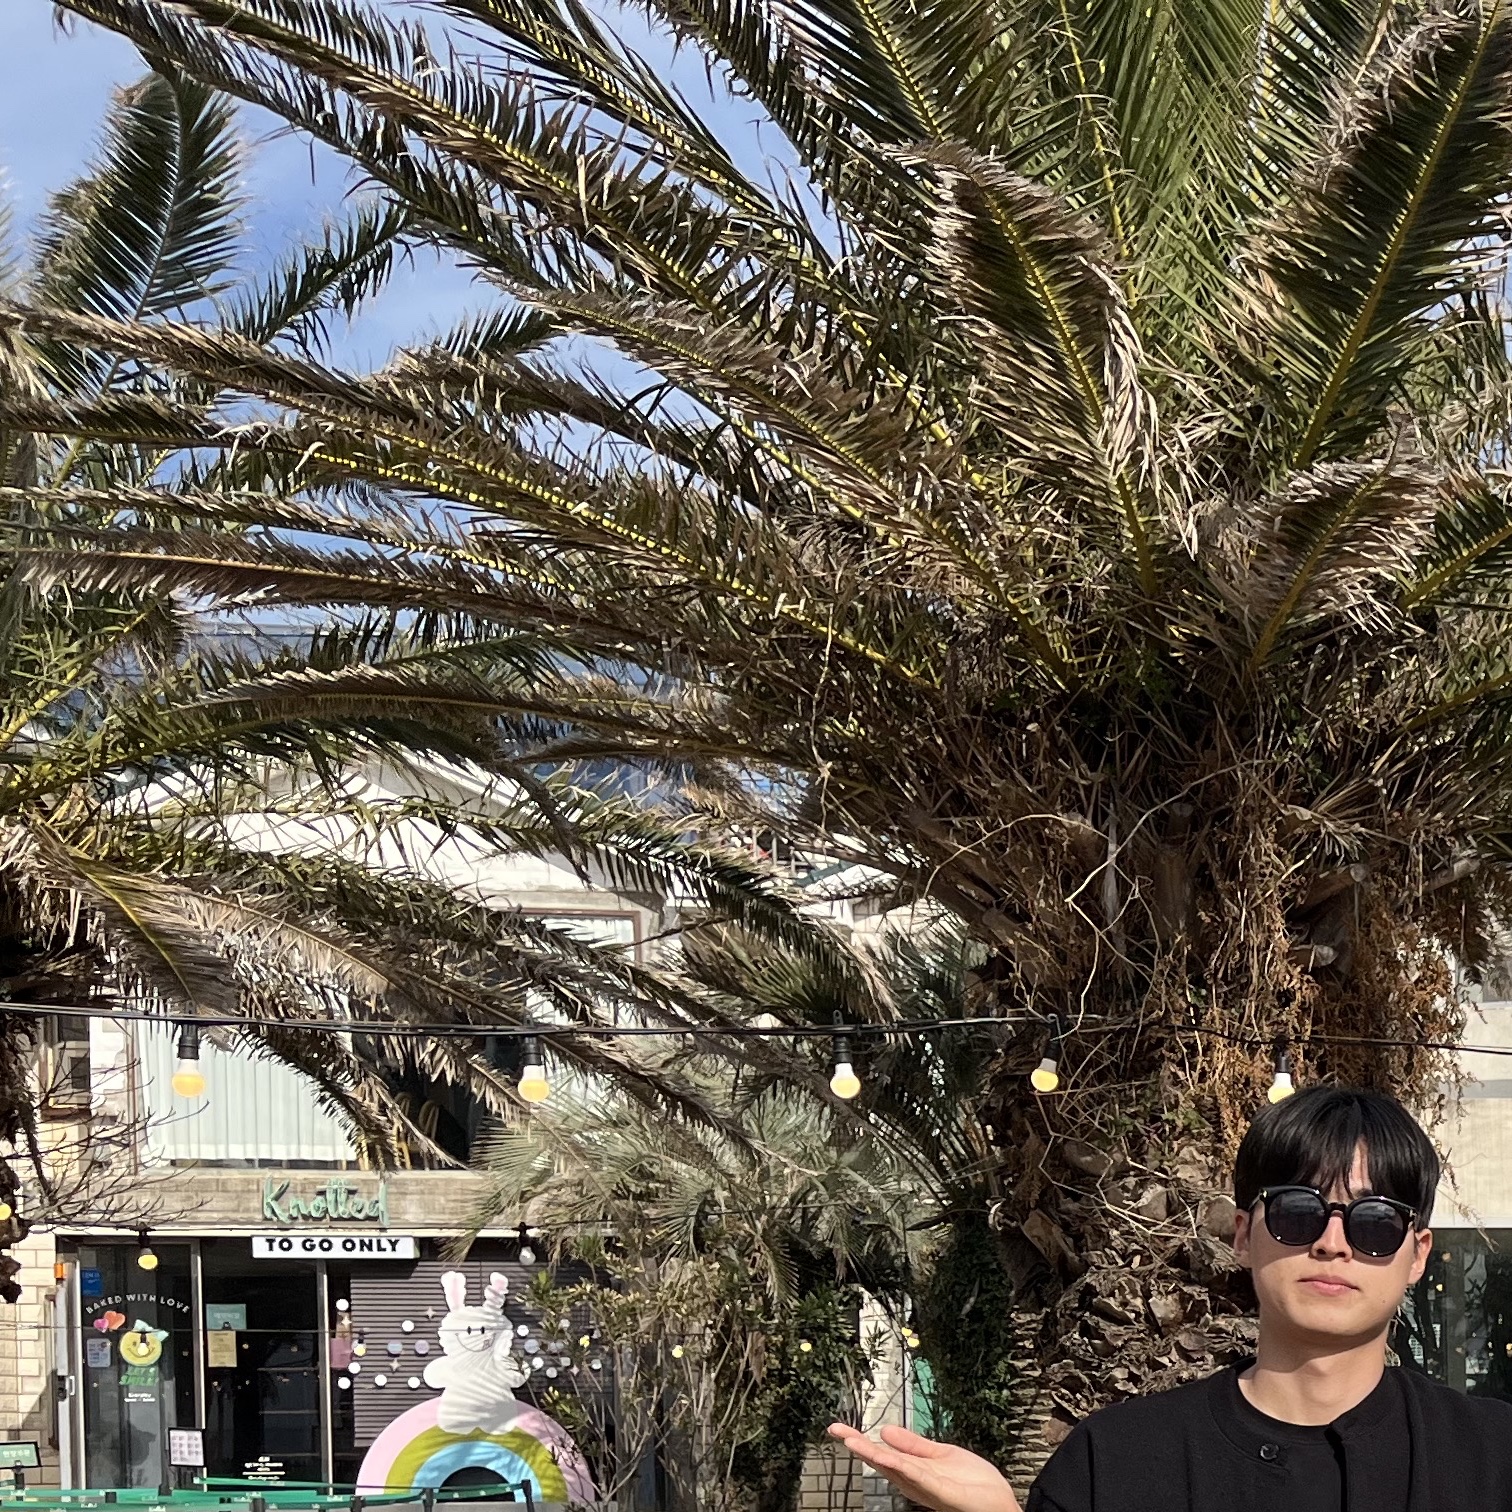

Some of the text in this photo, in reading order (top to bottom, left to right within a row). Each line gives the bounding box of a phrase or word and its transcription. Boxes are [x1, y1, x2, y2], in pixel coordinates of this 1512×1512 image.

[263, 1172, 391, 1228] Knotted
[265, 1238, 400, 1252] TO GO ONLY
[85, 1293, 190, 1314] BAKED WITH LOVE
